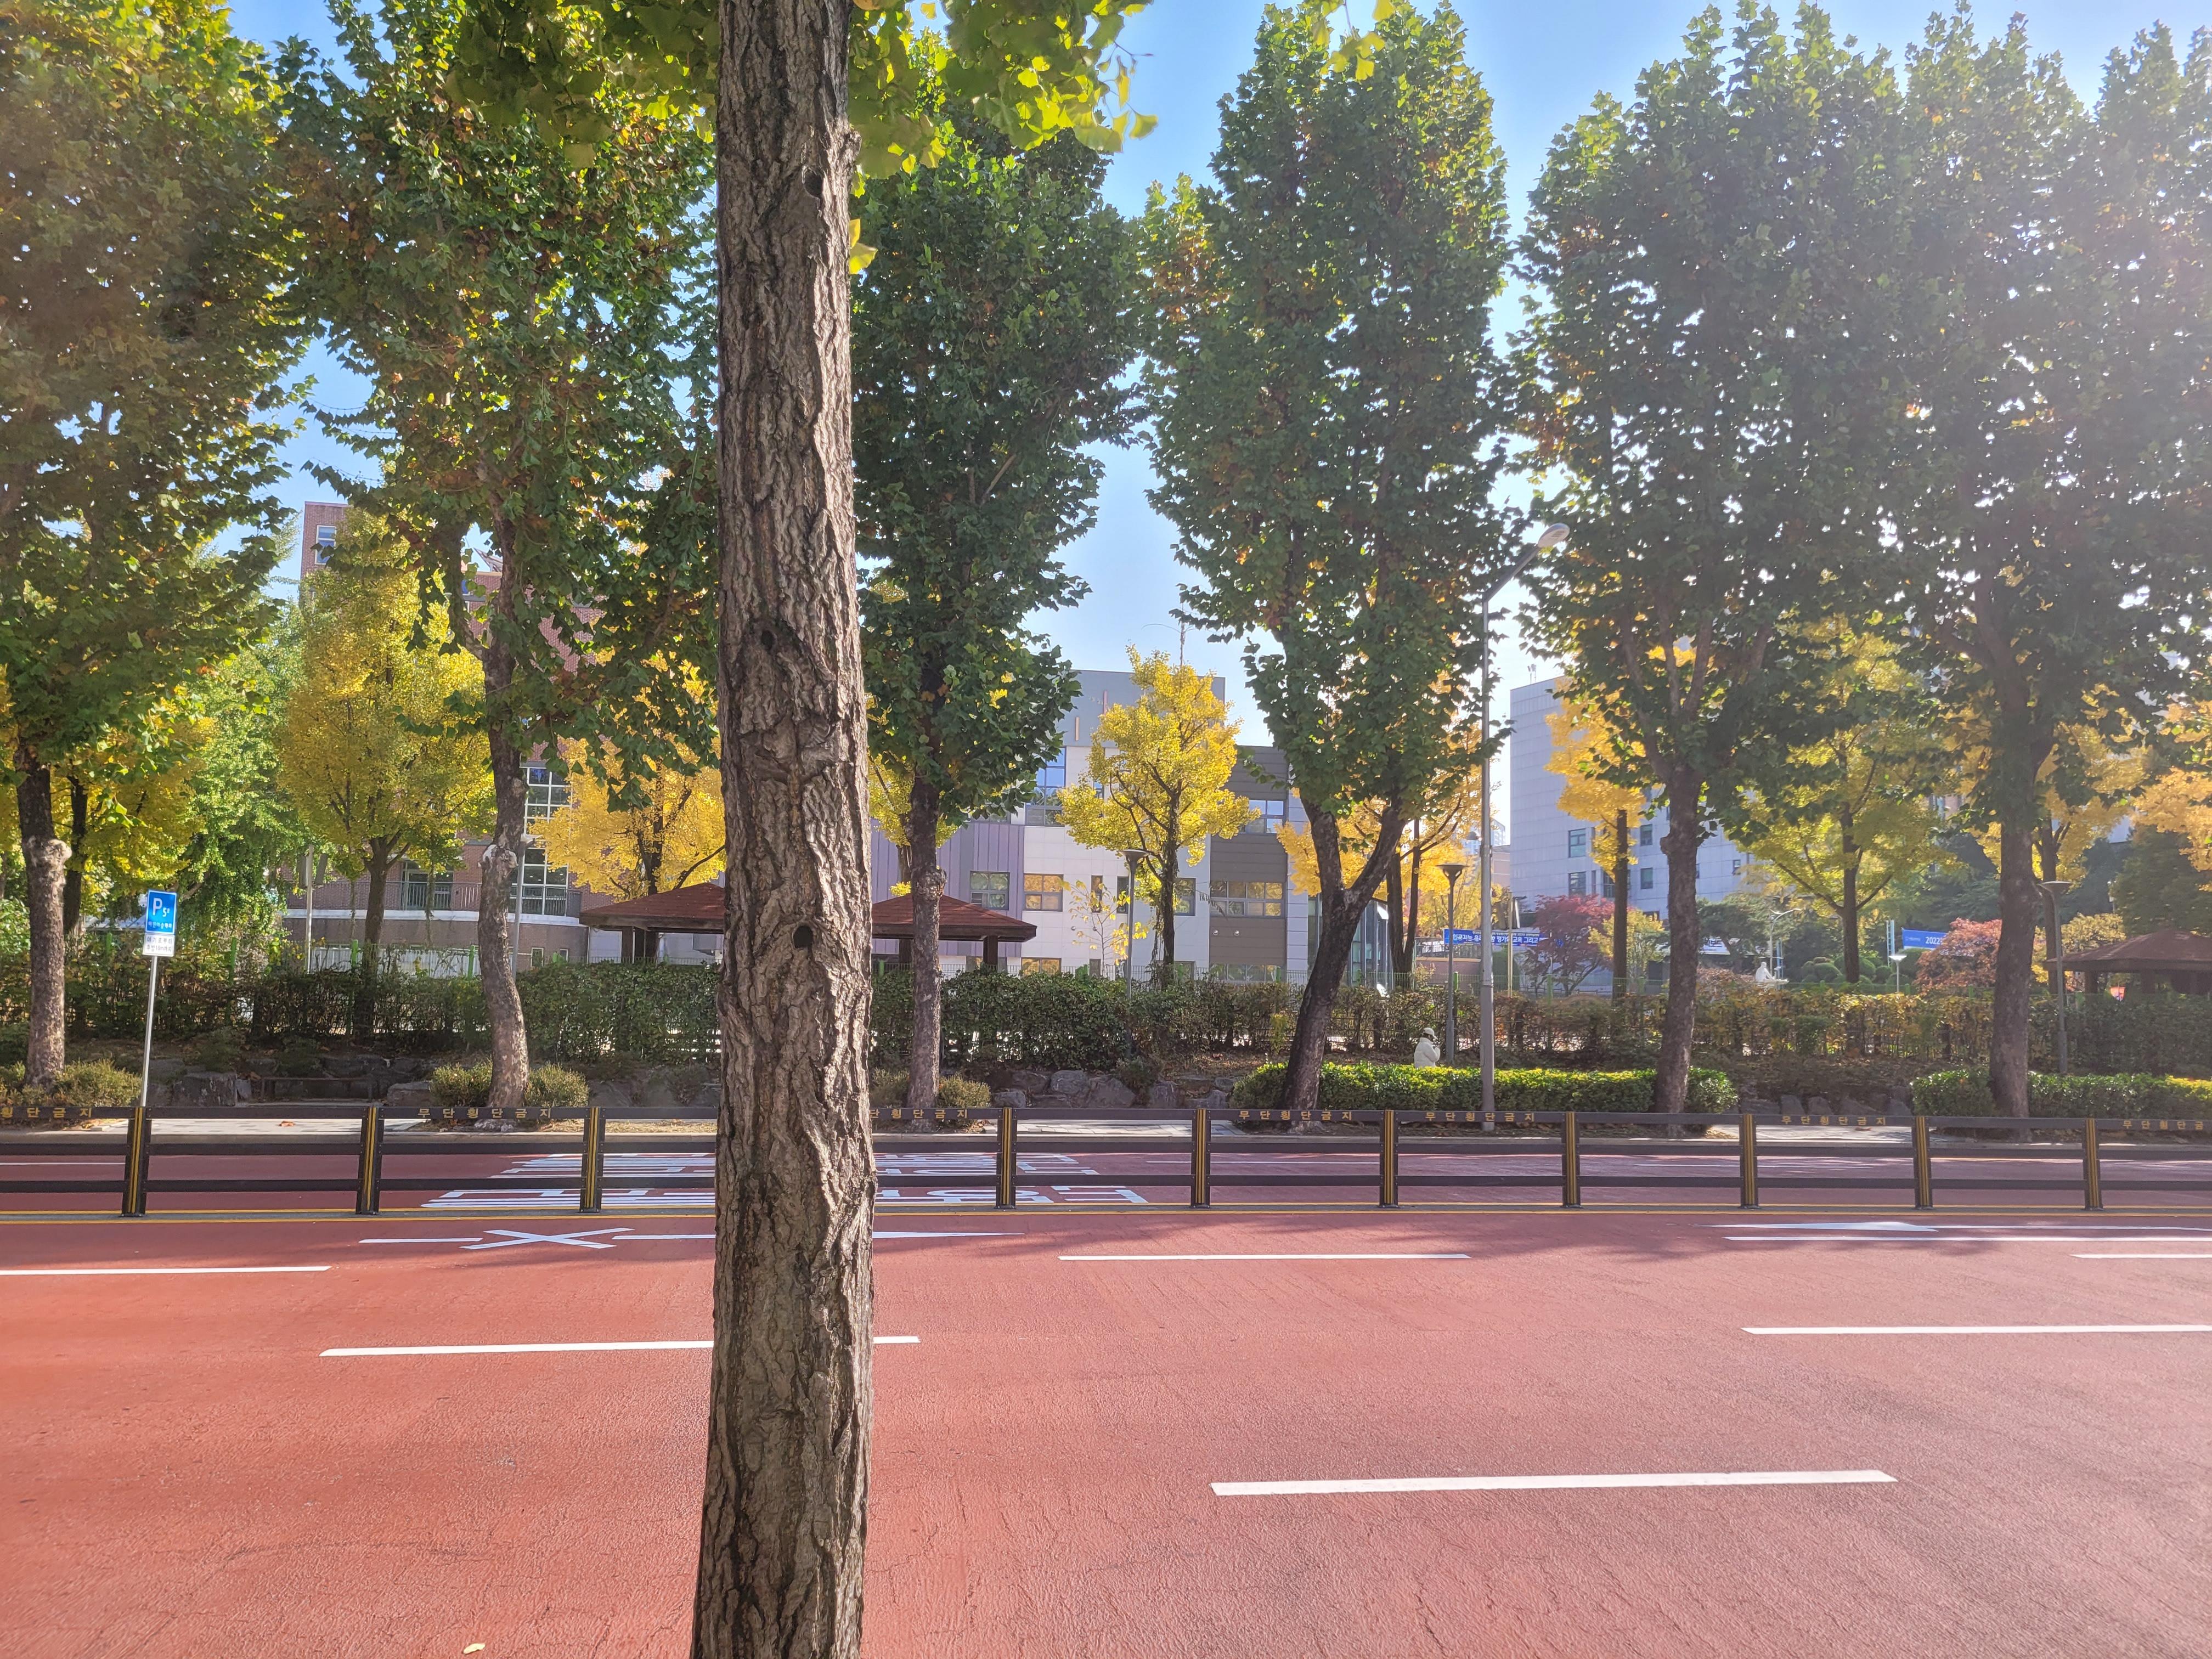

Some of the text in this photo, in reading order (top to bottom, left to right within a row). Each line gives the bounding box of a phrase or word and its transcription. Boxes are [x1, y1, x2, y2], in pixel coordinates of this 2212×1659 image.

[153, 898, 162, 916] P
[1925, 936, 1940, 945] 2022
[417, 1108, 552, 1119] 무단횡단금지
[869, 1108, 968, 1119] 단횡단금지
[1239, 1110, 1352, 1121] 무단횡단금지
[1425, 1111, 1534, 1122] 무단횡단금지
